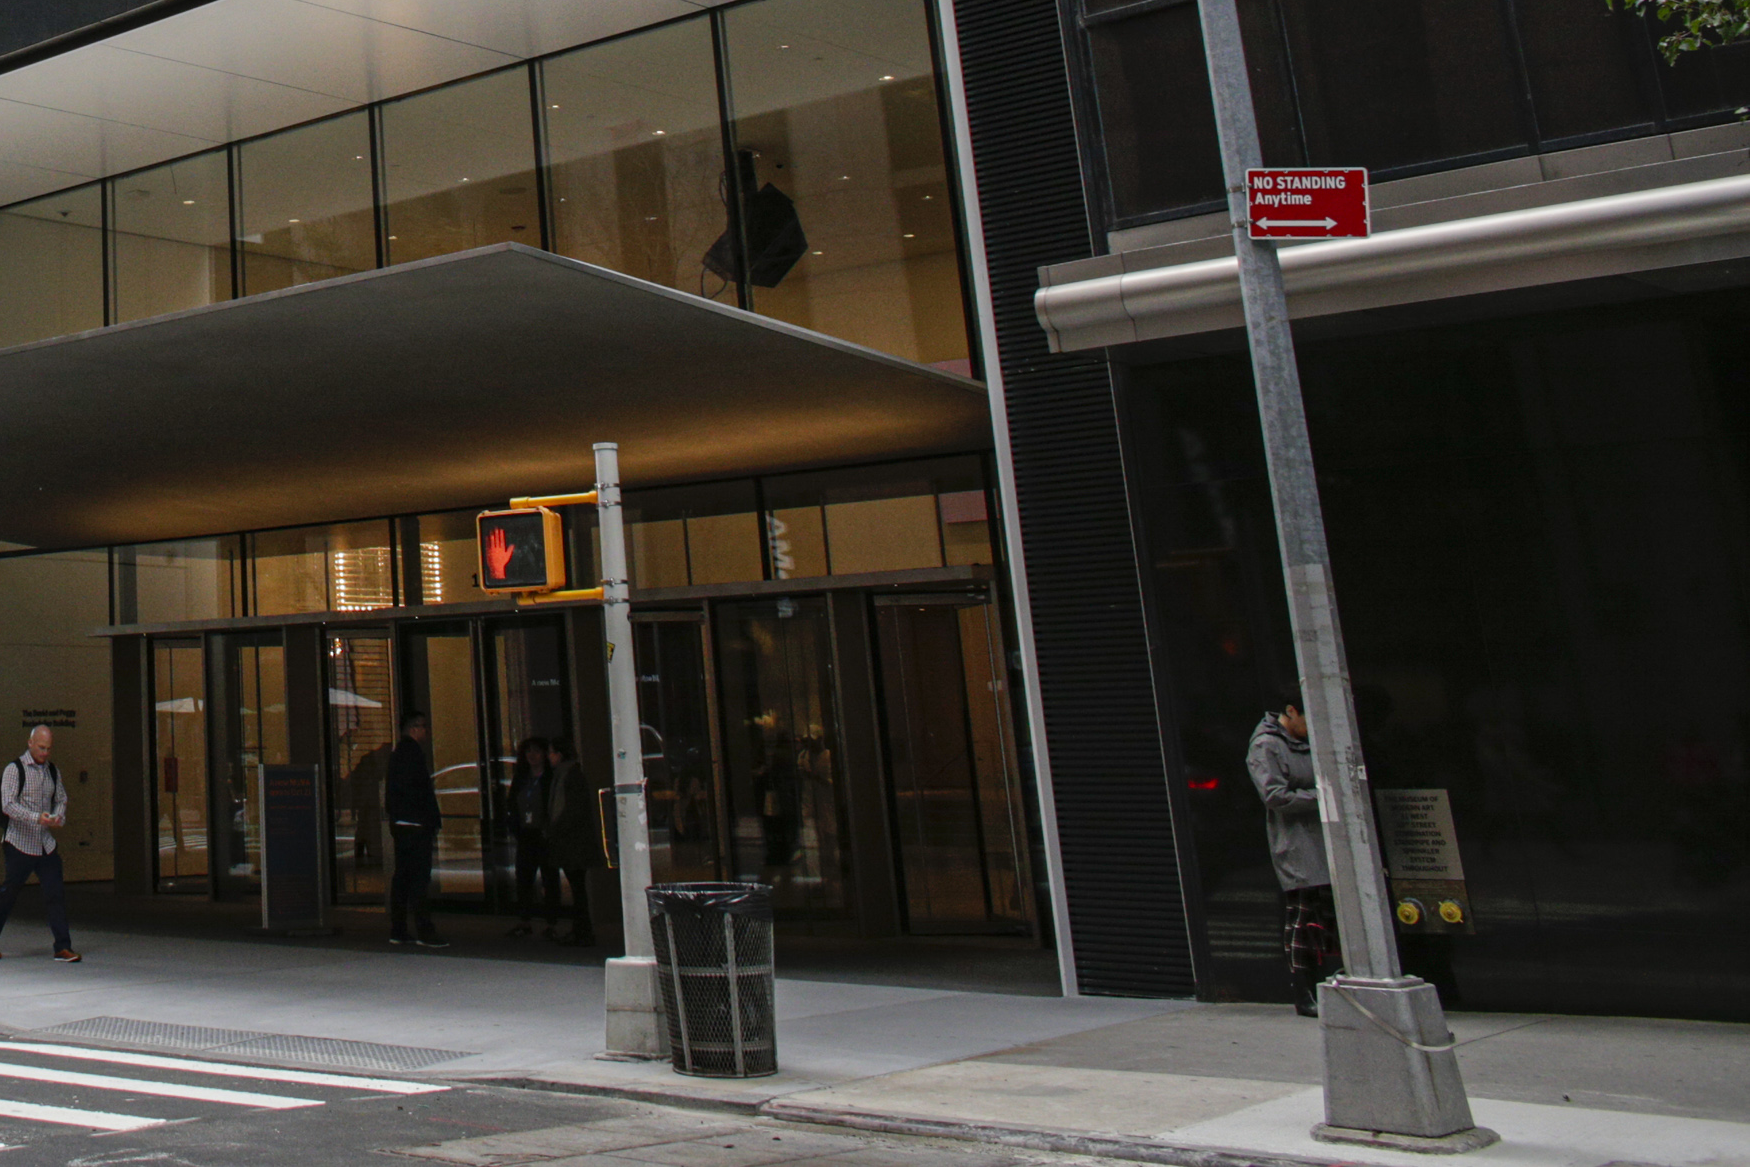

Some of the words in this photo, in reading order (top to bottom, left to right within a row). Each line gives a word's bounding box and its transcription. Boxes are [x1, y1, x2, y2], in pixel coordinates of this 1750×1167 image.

[1253, 176, 1274, 189] NO
[1276, 176, 1346, 189] STANDING
[1255, 192, 1312, 207] Anytime
